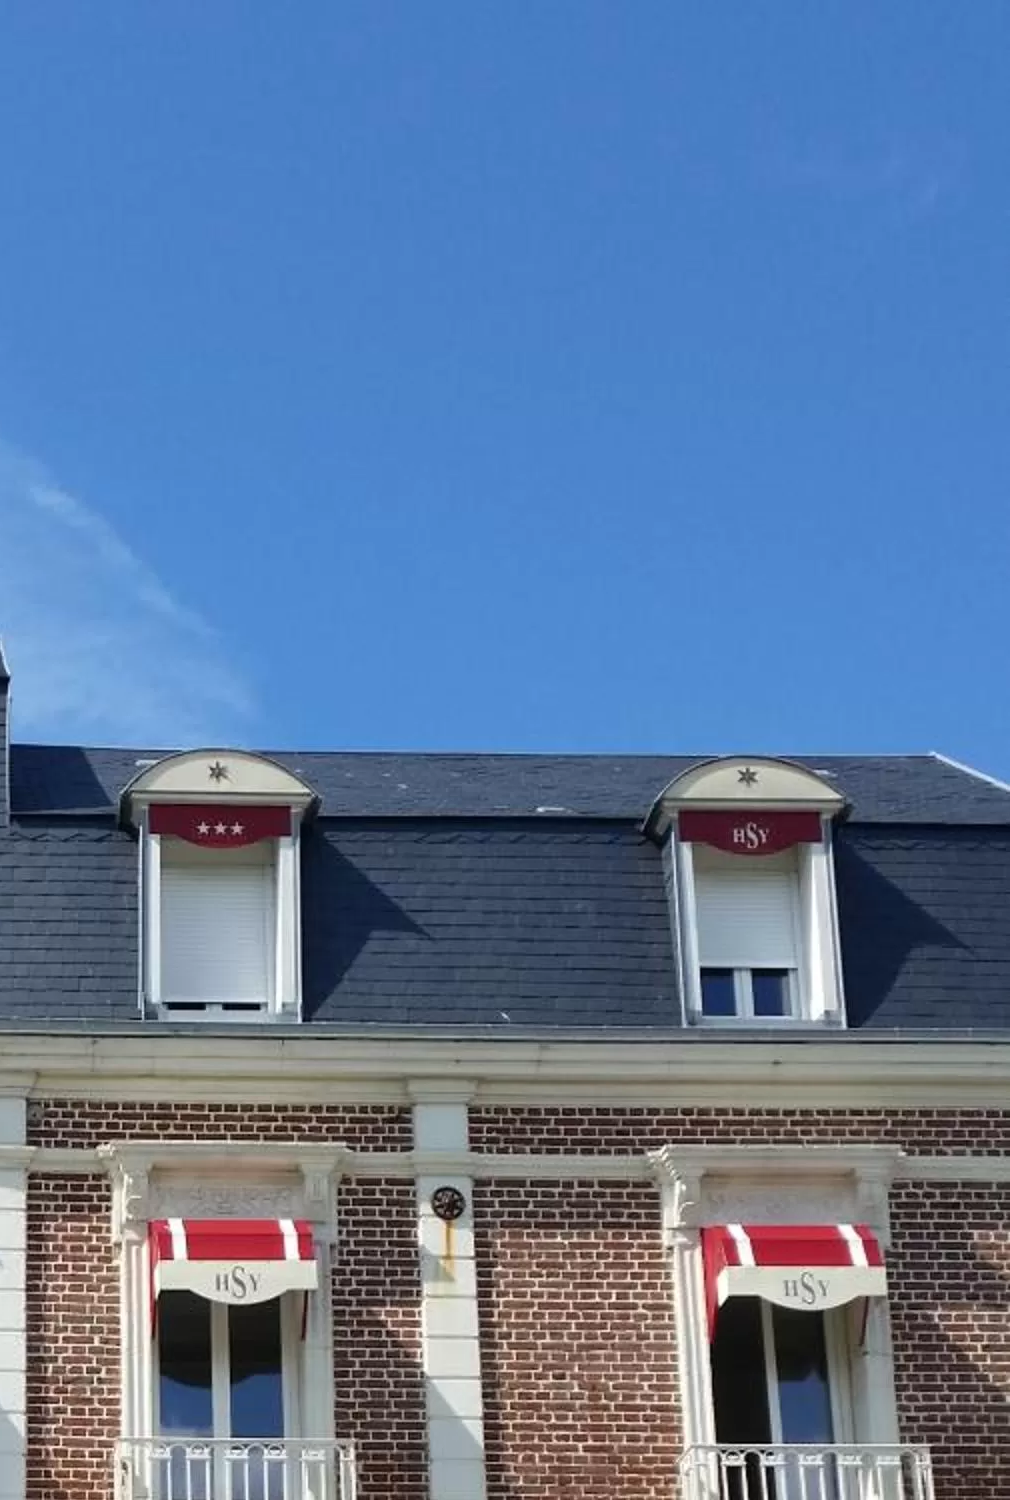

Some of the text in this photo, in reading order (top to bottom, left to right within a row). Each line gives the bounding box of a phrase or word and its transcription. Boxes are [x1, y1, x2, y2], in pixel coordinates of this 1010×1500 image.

[733, 821, 769, 848] HSY
[215, 1265, 261, 1298] HSY
[783, 1271, 830, 1304] HSY
